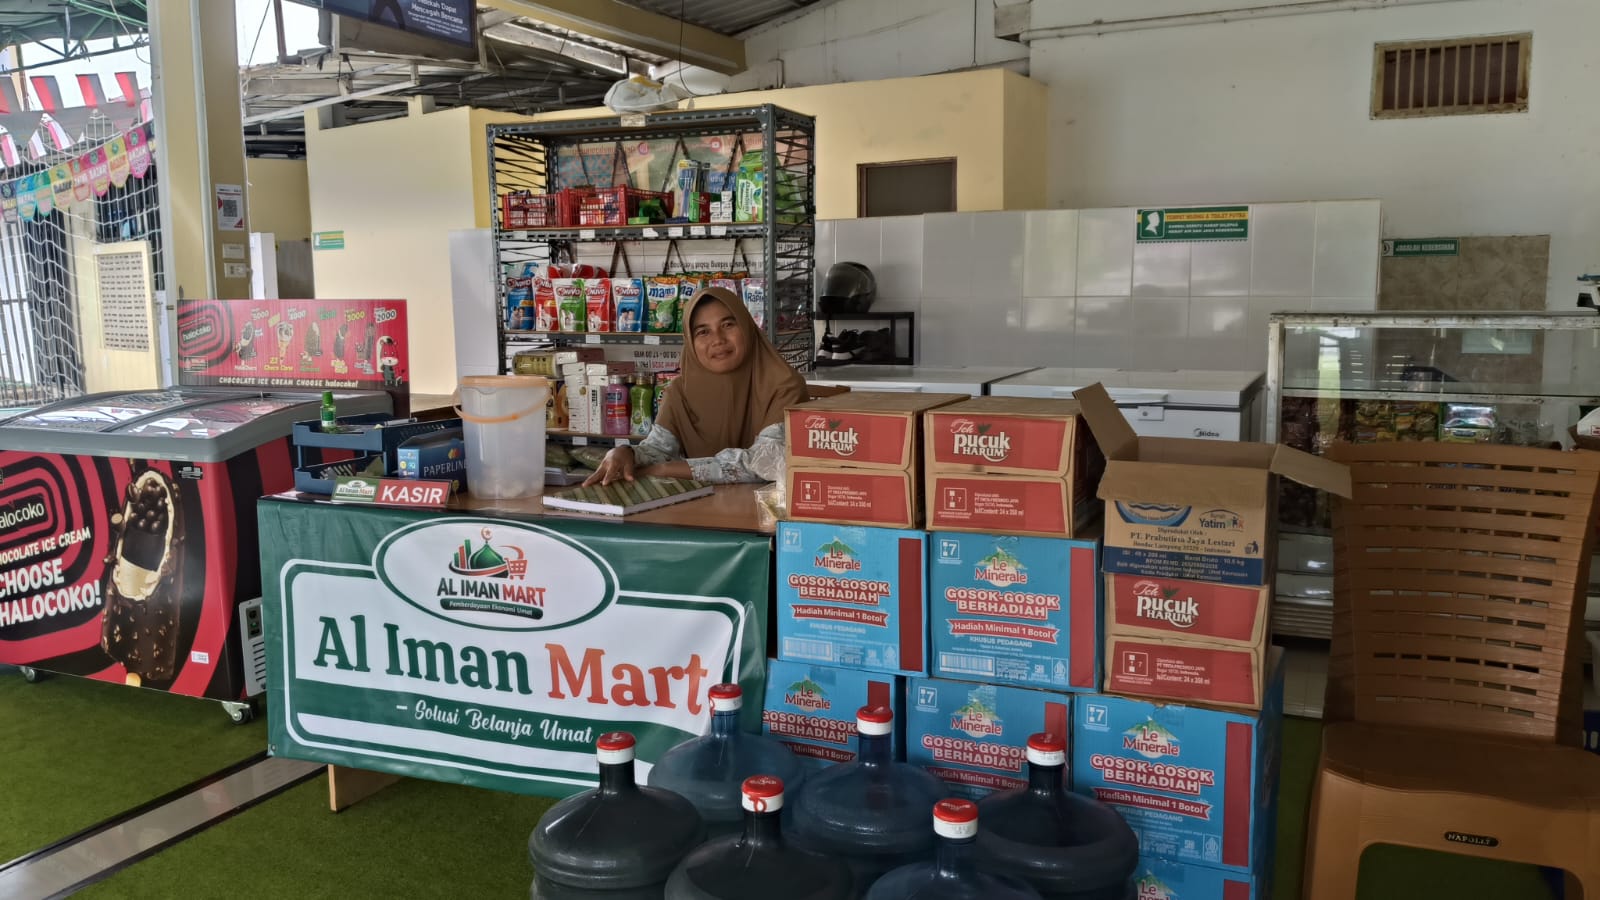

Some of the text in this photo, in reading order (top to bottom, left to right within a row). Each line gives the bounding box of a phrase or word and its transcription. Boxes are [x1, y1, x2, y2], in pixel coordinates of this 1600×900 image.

[411, 2, 441, 17] Mencegah
[219, 376, 256, 385] CHOCOLATE
[258, 377, 269, 385] ICE
[271, 377, 293, 386] CREAM
[296, 378, 323, 387] CHOOSE
[816, 441, 854, 453] HARUM
[962, 447, 1005, 459] HARUM
[381, 485, 443, 504] KASIR
[0, 503, 45, 529] alocoko
[1199, 518, 1226, 529] Yatim
[42, 537, 57, 552] ICE
[59, 527, 91, 548] CREAM
[792, 532, 799, 545] 7
[830, 546, 843, 560] Le
[948, 543, 957, 556] 7
[814, 556, 861, 571] Minerale
[992, 557, 1007, 571] Le
[789, 574, 889, 593] GOSOK-GOSOK
[974, 567, 1028, 584] Minerale
[436, 577, 546, 607] AL IMAN MART
[799, 585, 877, 602] BERHADIAH
[945, 587, 1059, 607] GOSOK-GOSOK
[0, 580, 101, 627] HALOCOKO!
[491, 603, 516, 614] Ekonomi
[958, 600, 1045, 617] BERHADIAH
[796, 607, 822, 615] Hadiah
[823, 608, 855, 619] Minimal
[862, 613, 882, 623] Botol
[1146, 610, 1195, 625] HARUM
[954, 622, 984, 631] Hadiah
[985, 623, 1020, 634] Minimal
[1027, 629, 1051, 639] Botol
[996, 638, 1033, 648] PEDAGANG
[312, 614, 709, 716] Al Iman Mart
[800, 684, 813, 697] Le
[926, 691, 934, 704] 7
[784, 692, 832, 710] Minerale
[414, 699, 594, 744] Solusi Belanja Umat
[969, 707, 983, 722] Le
[1095, 709, 1105, 722] 7
[770, 722, 846, 741] BERHADIAH
[951, 718, 1003, 735] Minerale
[1142, 726, 1159, 743] Le
[794, 744, 825, 756] Minimal
[831, 751, 851, 761] Botol
[1123, 736, 1180, 756] Minerale
[934, 748, 1020, 769] BERHADIAH
[1091, 754, 1214, 784] GOSOK-GOSOK
[960, 771, 994, 785] Minimal
[1103, 768, 1199, 793] BERHADIAH
[1100, 791, 1131, 801] Hadiah
[1132, 794, 1170, 808] Minimal
[1179, 802, 1203, 814] Botol
[1141, 880, 1157, 895] Le
